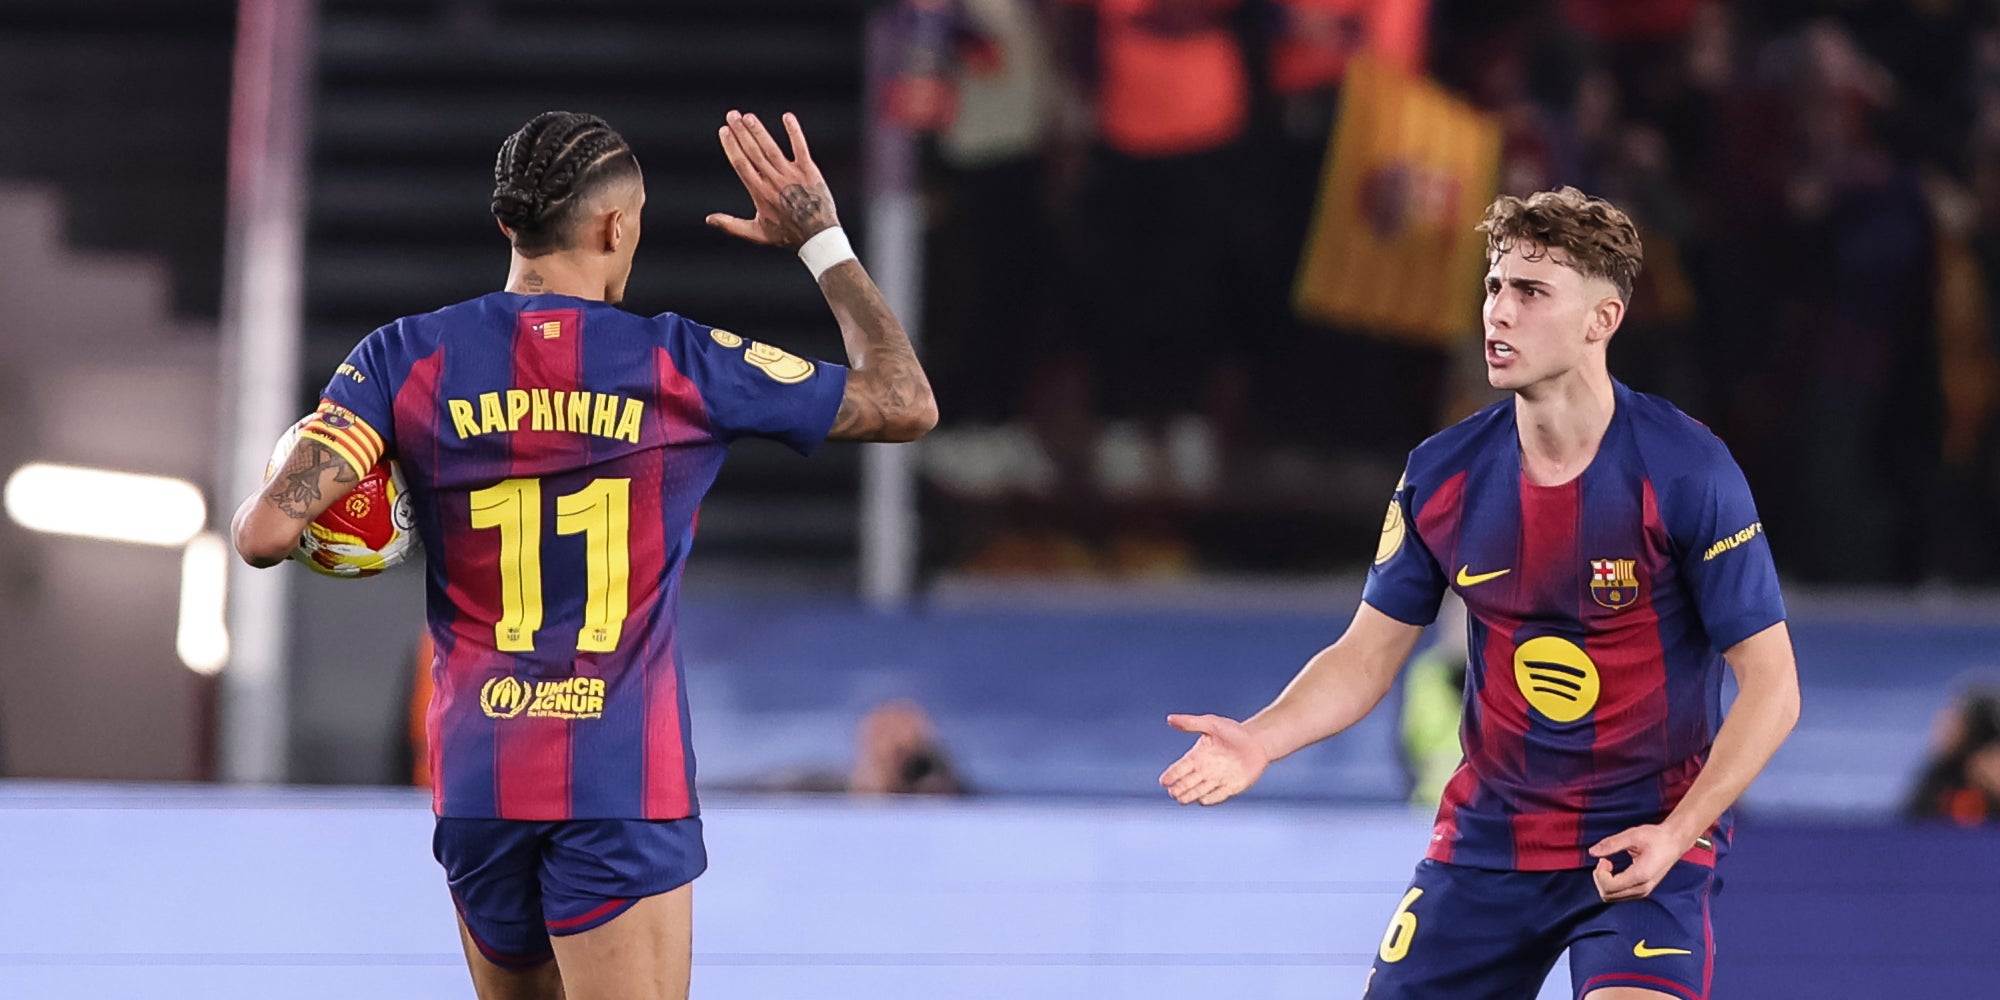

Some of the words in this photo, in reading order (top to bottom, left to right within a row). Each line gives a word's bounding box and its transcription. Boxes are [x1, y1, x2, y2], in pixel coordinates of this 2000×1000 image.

[448, 388, 644, 443] RAPHINHA
[470, 478, 631, 652] 11
[528, 694, 604, 712] ACNUR
[1379, 886, 1424, 963] 6
